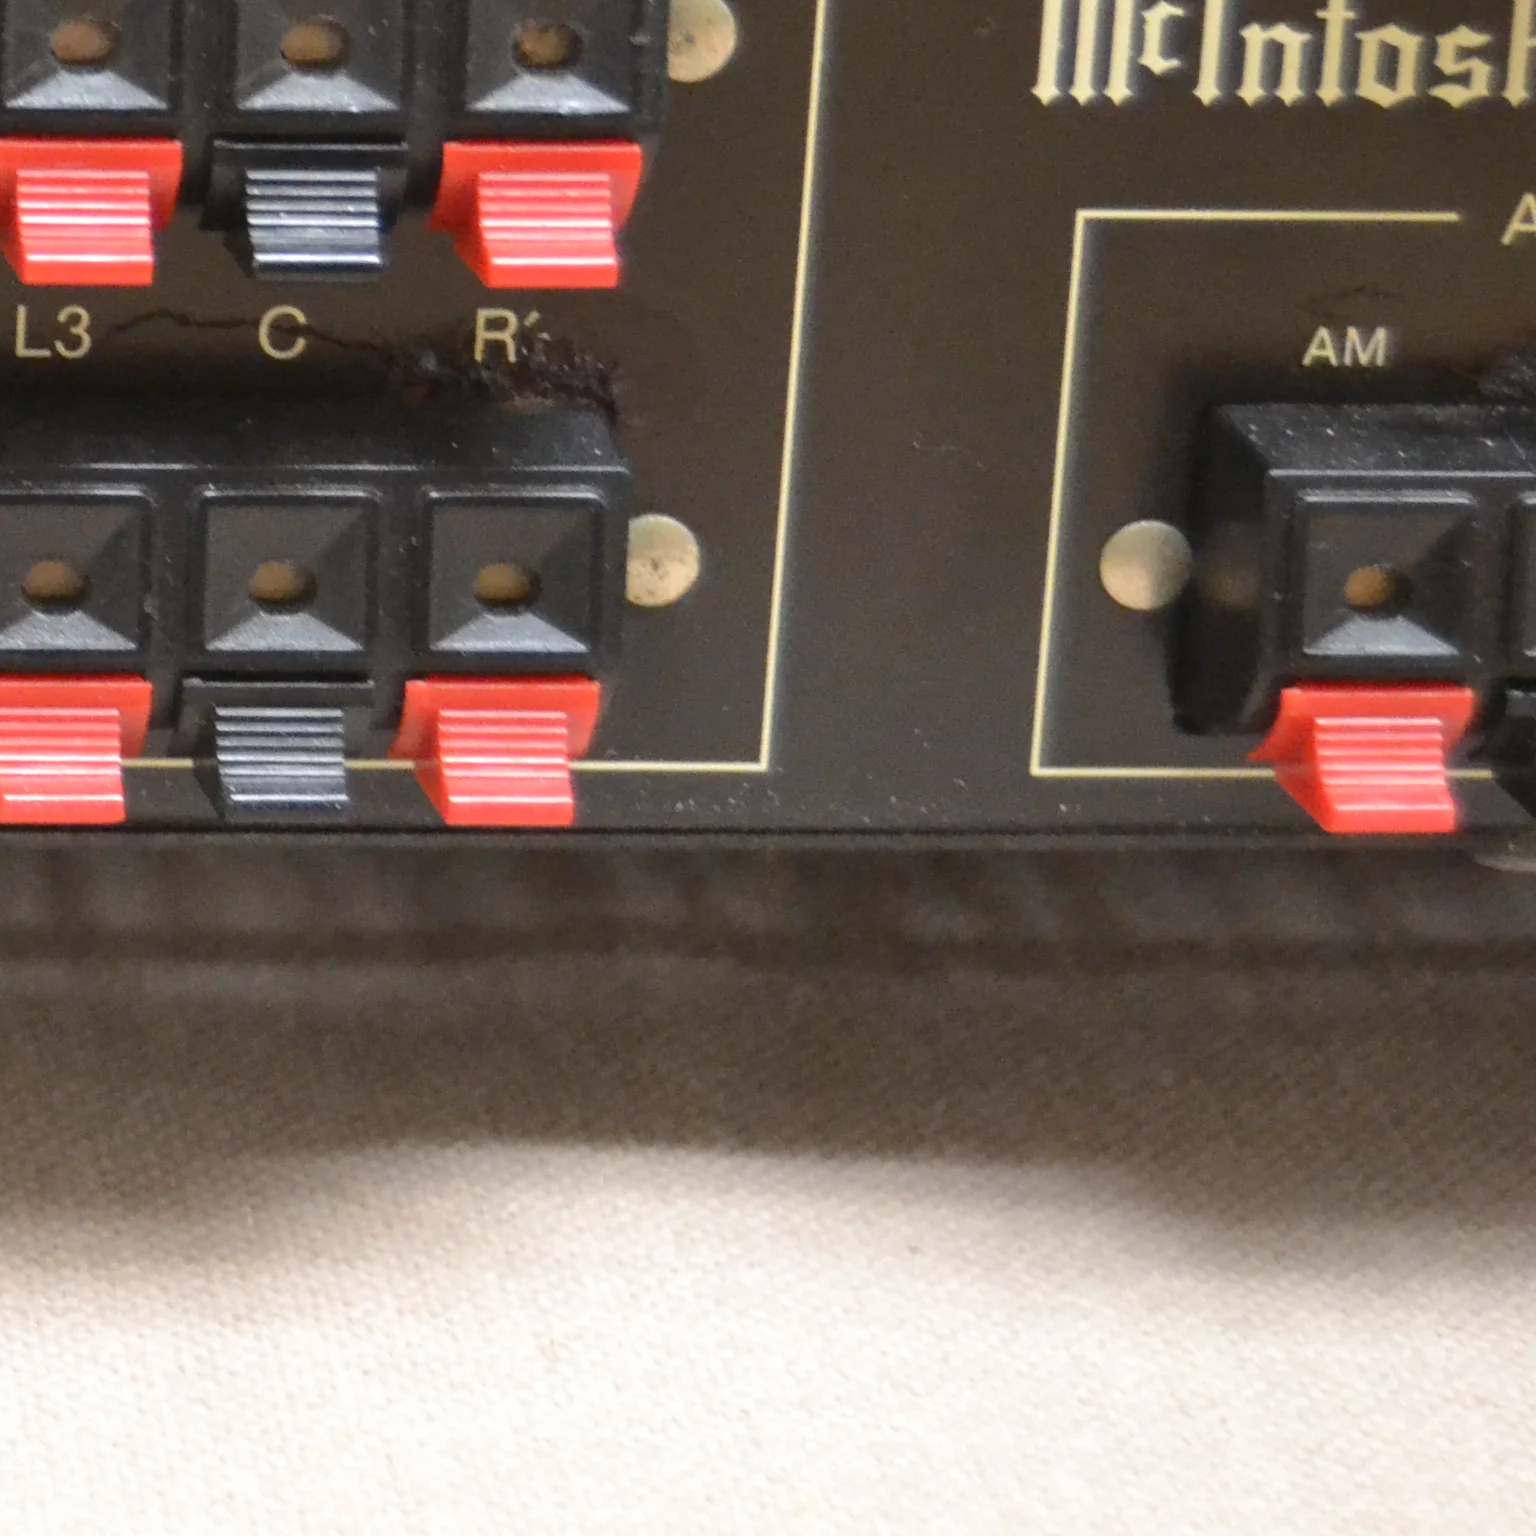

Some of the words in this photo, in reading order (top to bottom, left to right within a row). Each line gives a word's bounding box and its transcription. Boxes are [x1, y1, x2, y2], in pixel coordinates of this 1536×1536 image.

[16, 304, 91, 358] L3
[259, 304, 307, 359] C
[1303, 326, 1389, 366] AM
